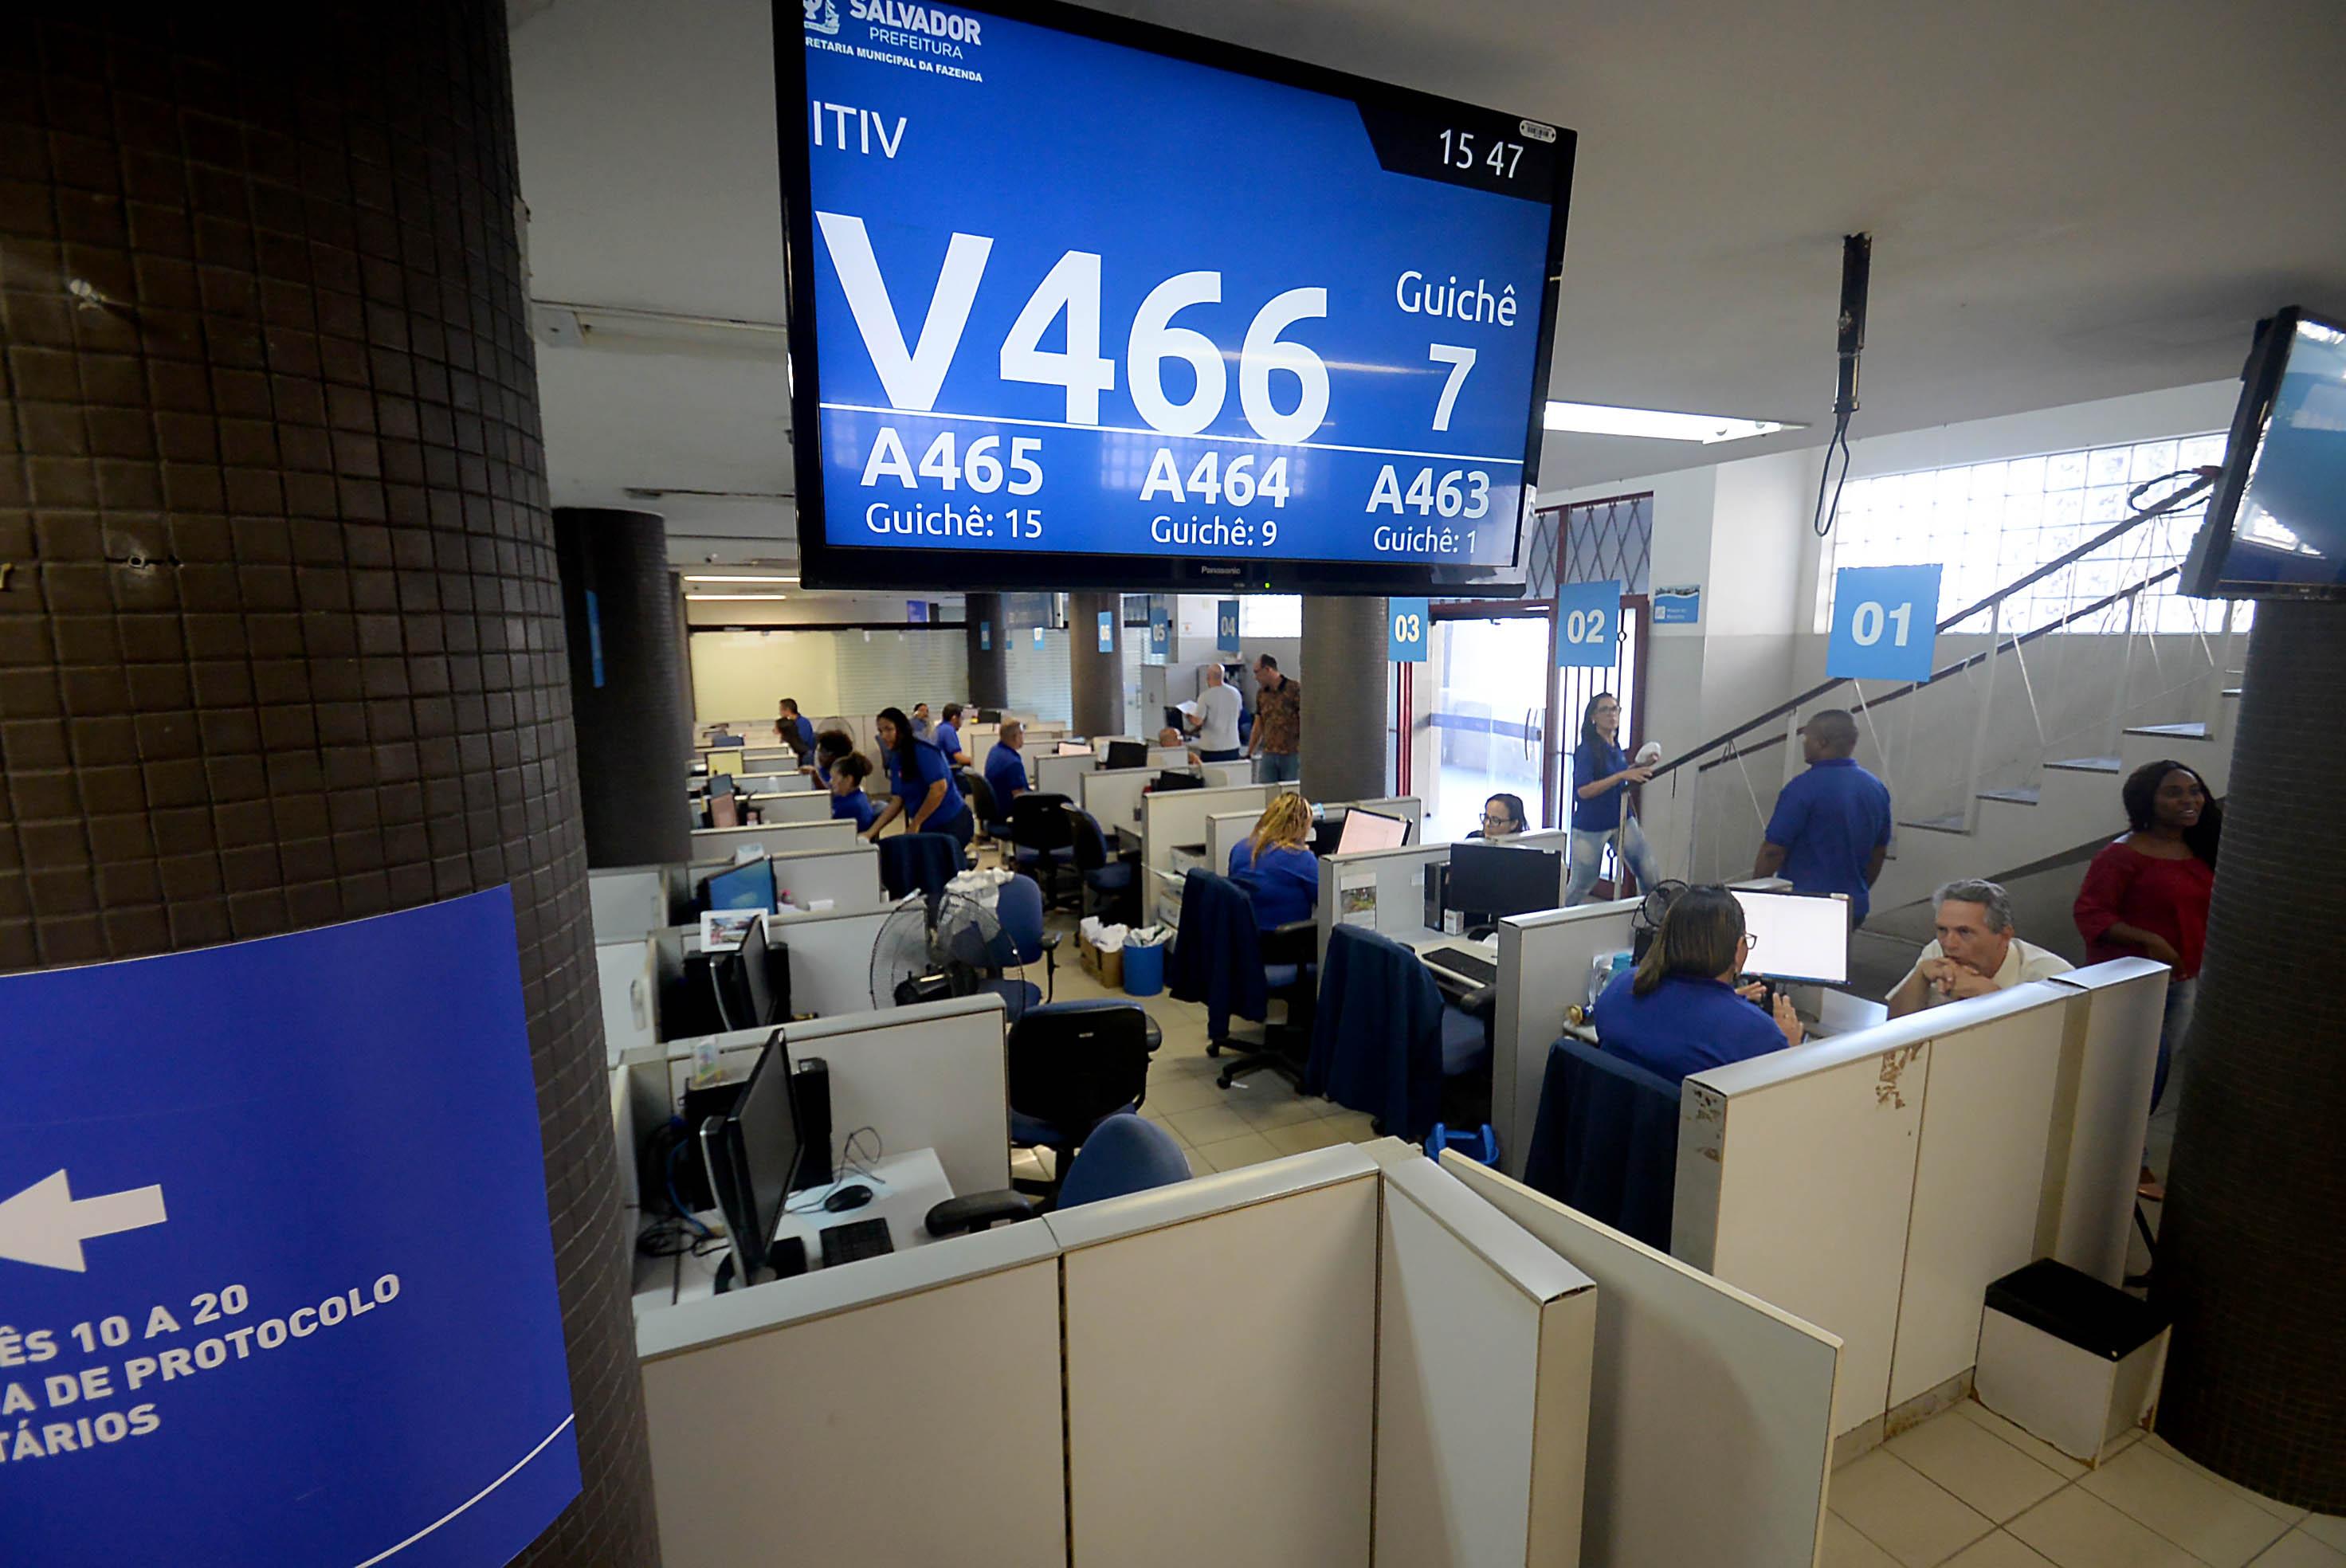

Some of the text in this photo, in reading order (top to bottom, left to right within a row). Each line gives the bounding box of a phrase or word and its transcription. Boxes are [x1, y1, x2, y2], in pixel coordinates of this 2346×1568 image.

[849, 0, 981, 45] SALVADOR
[869, 26, 963, 60] PREFEITURA
[857, 47, 916, 69] MUNICIPAL
[919, 61, 933, 73] DA
[936, 64, 983, 83] FAZENDA
[813, 100, 907, 159] ITIV
[1440, 129, 1474, 169] 15
[1486, 141, 1524, 178] 47
[1396, 270, 1517, 327] Guichê
[814, 211, 1330, 443] V466
[1429, 343, 1477, 432] 7
[860, 427, 1044, 496] A465
[1140, 448, 1290, 508] A464
[1365, 465, 1490, 519] A463
[865, 503, 1042, 539] Guichê: 15
[1151, 515, 1277, 547] Guichê: 9
[1373, 526, 1476, 555] Guichê: 1
[1201, 565, 1241, 574] Panasonic
[1222, 616, 1236, 637] 04
[1395, 613, 1420, 643] 03
[1567, 609, 1606, 645] 02
[1852, 601, 1912, 647] 01
[44, 1366, 114, 1408] DE
[124, 1273, 400, 1390] PROTOCOLO
[71, 1315, 131, 1353] 10
[144, 1305, 181, 1339] A
[190, 1284, 249, 1326] 20
